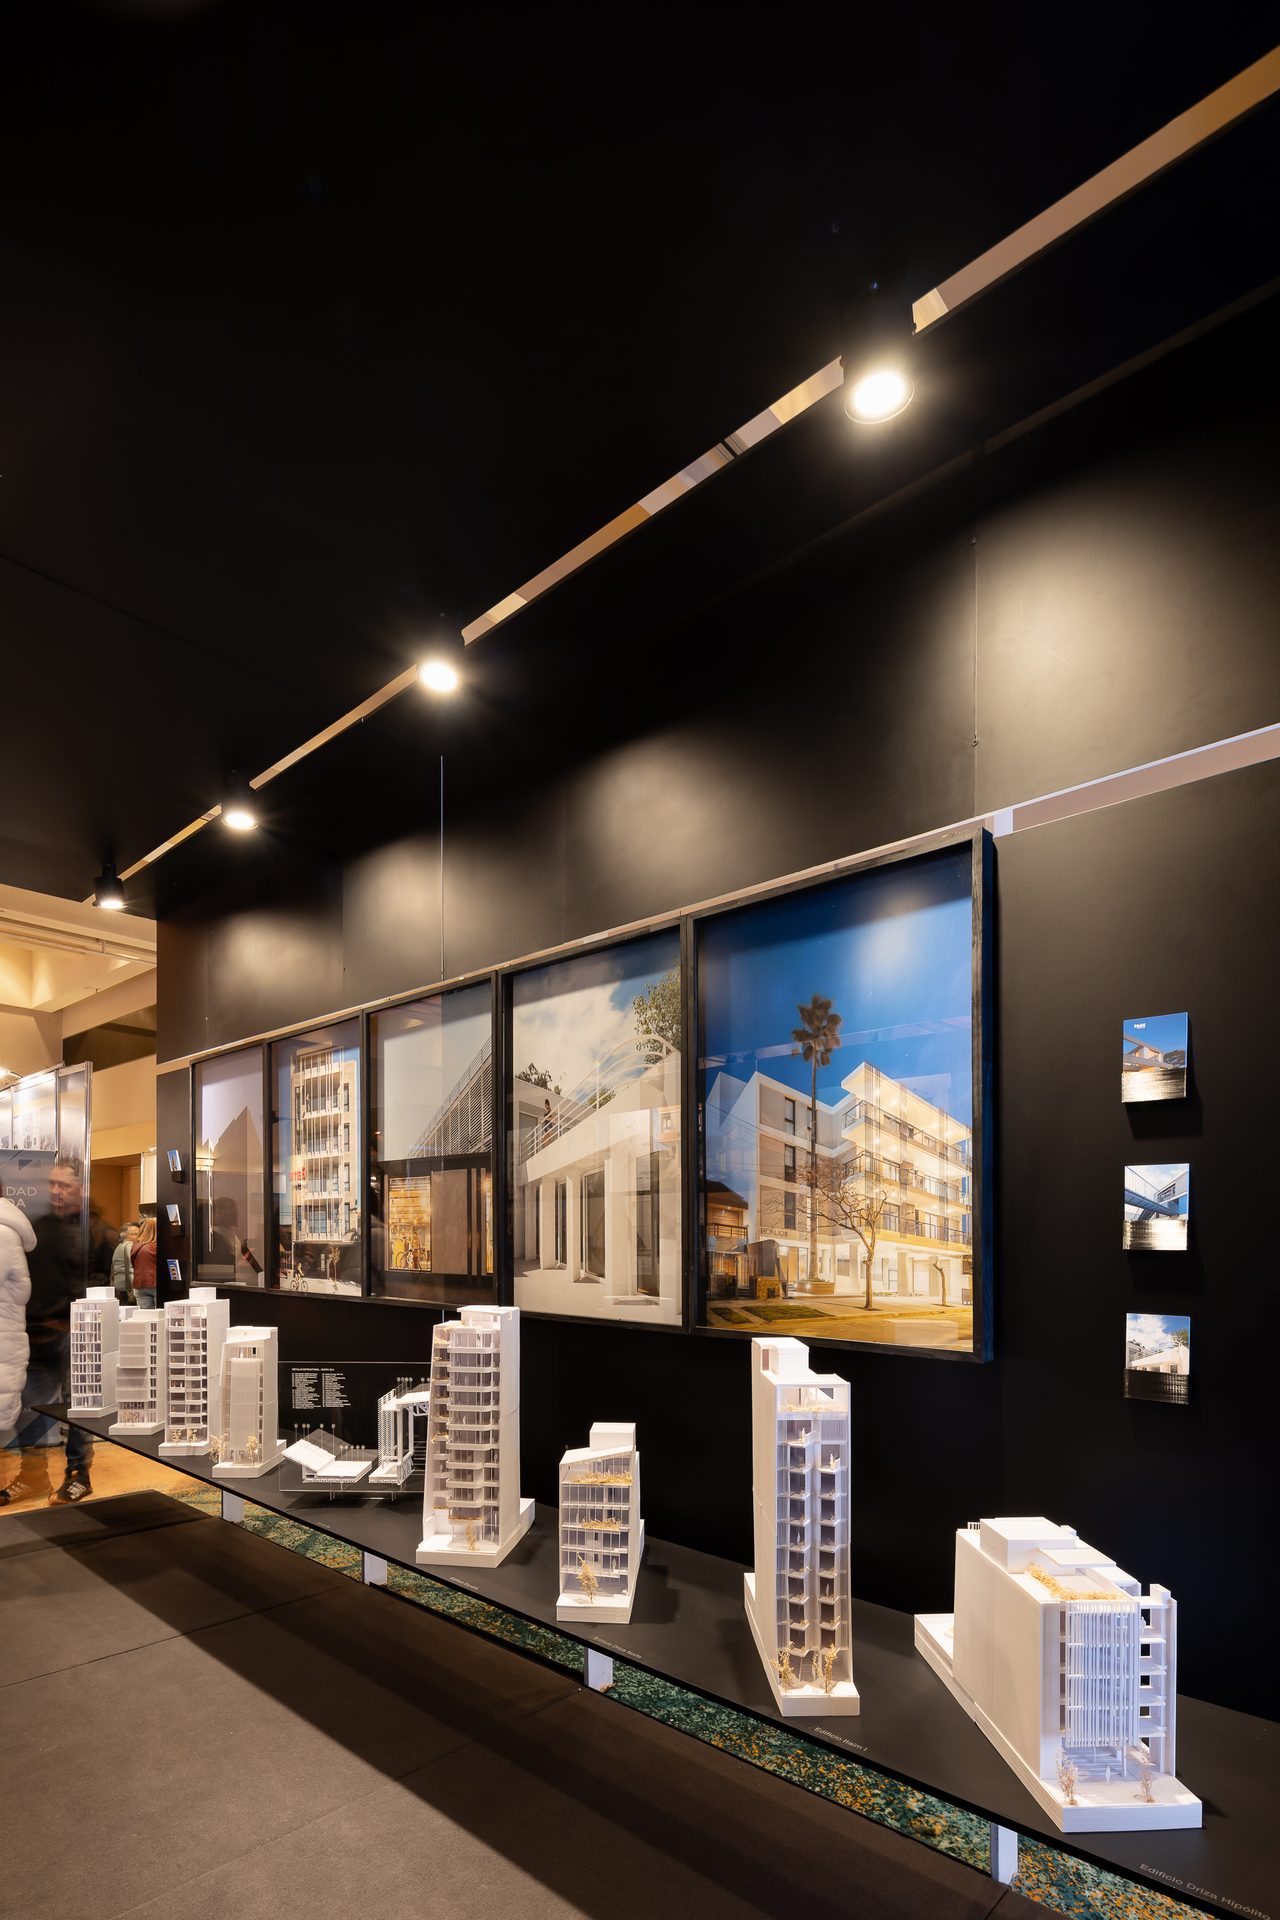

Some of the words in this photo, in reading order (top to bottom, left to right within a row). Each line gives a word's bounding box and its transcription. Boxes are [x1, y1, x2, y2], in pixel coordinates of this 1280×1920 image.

[814, 1726, 842, 1741] Edificio
[1139, 1863, 1184, 1886] Edificio
[1186, 1881, 1218, 1900] Driza
